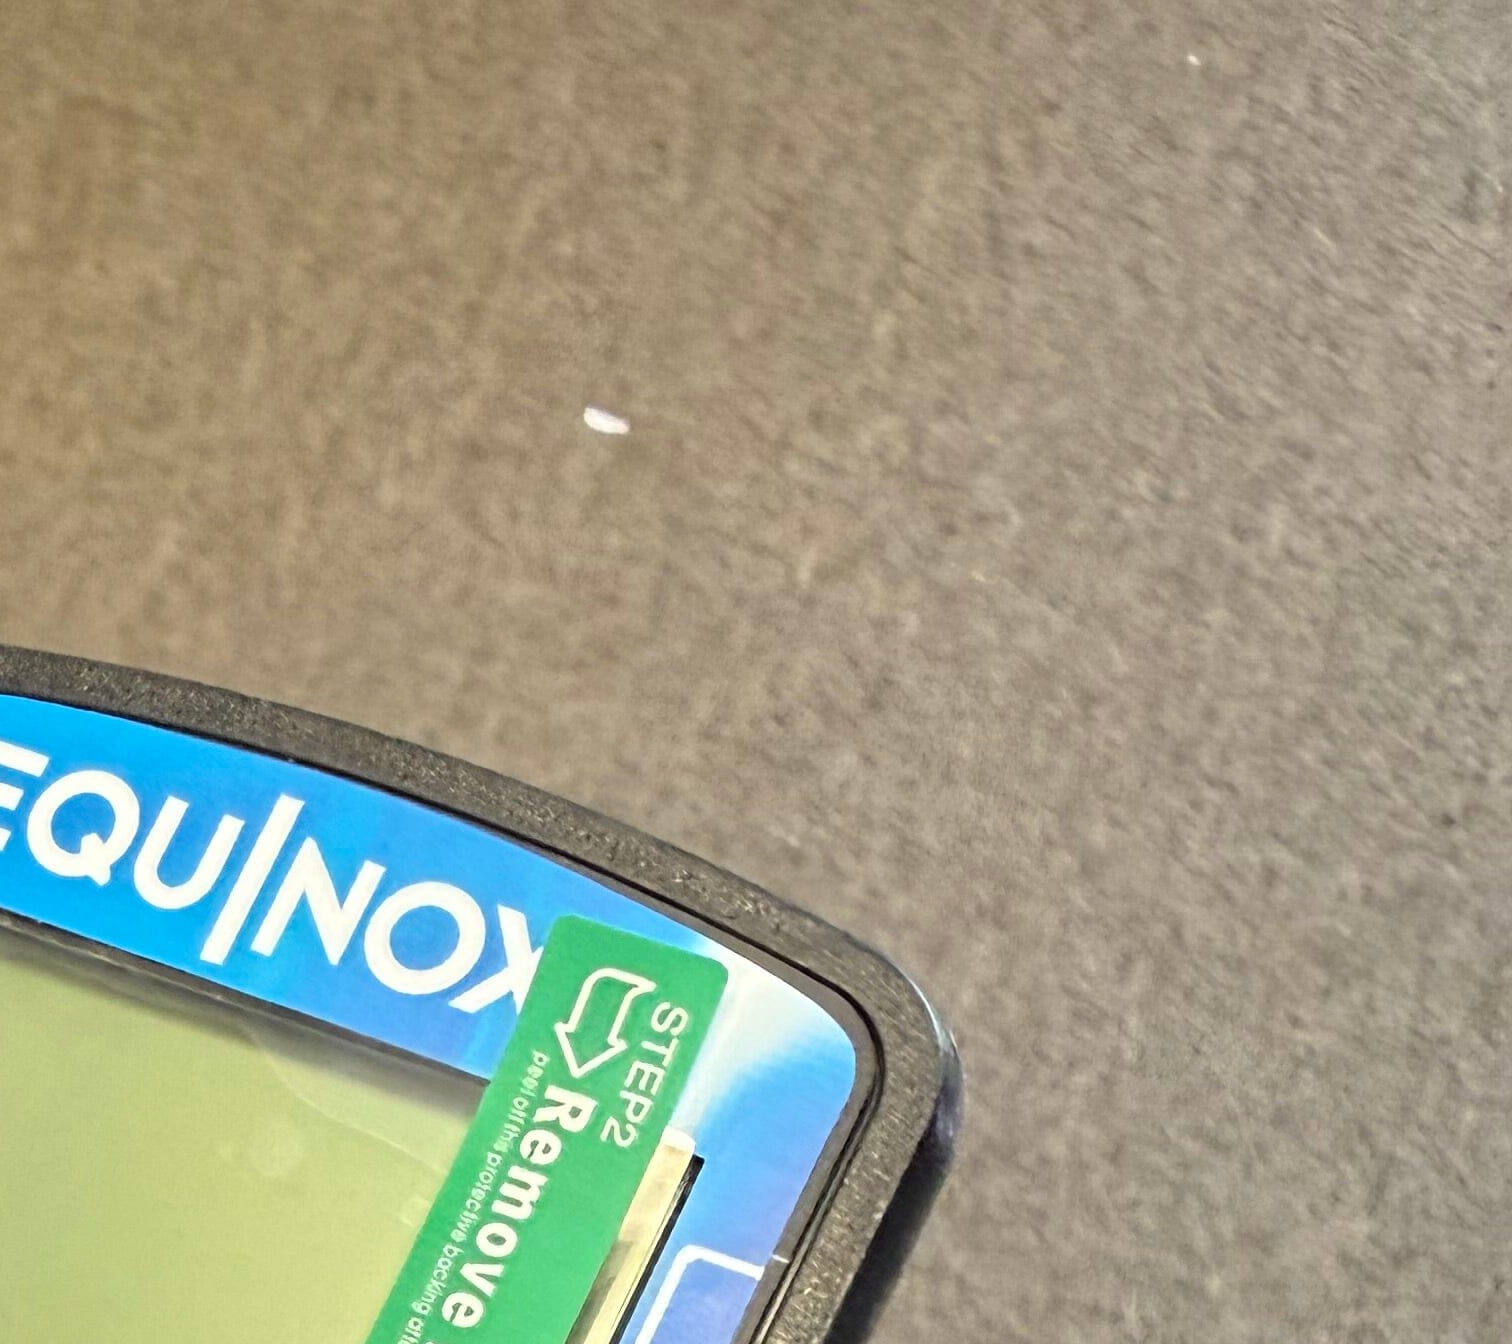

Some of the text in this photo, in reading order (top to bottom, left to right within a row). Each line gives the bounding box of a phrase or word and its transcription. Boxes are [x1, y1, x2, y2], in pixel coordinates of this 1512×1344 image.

[601, 1002, 689, 1148] STEP2
[442, 1085, 598, 1328] Remove
[450, 1152, 503, 1243] protective
[411, 1244, 464, 1316] backing
